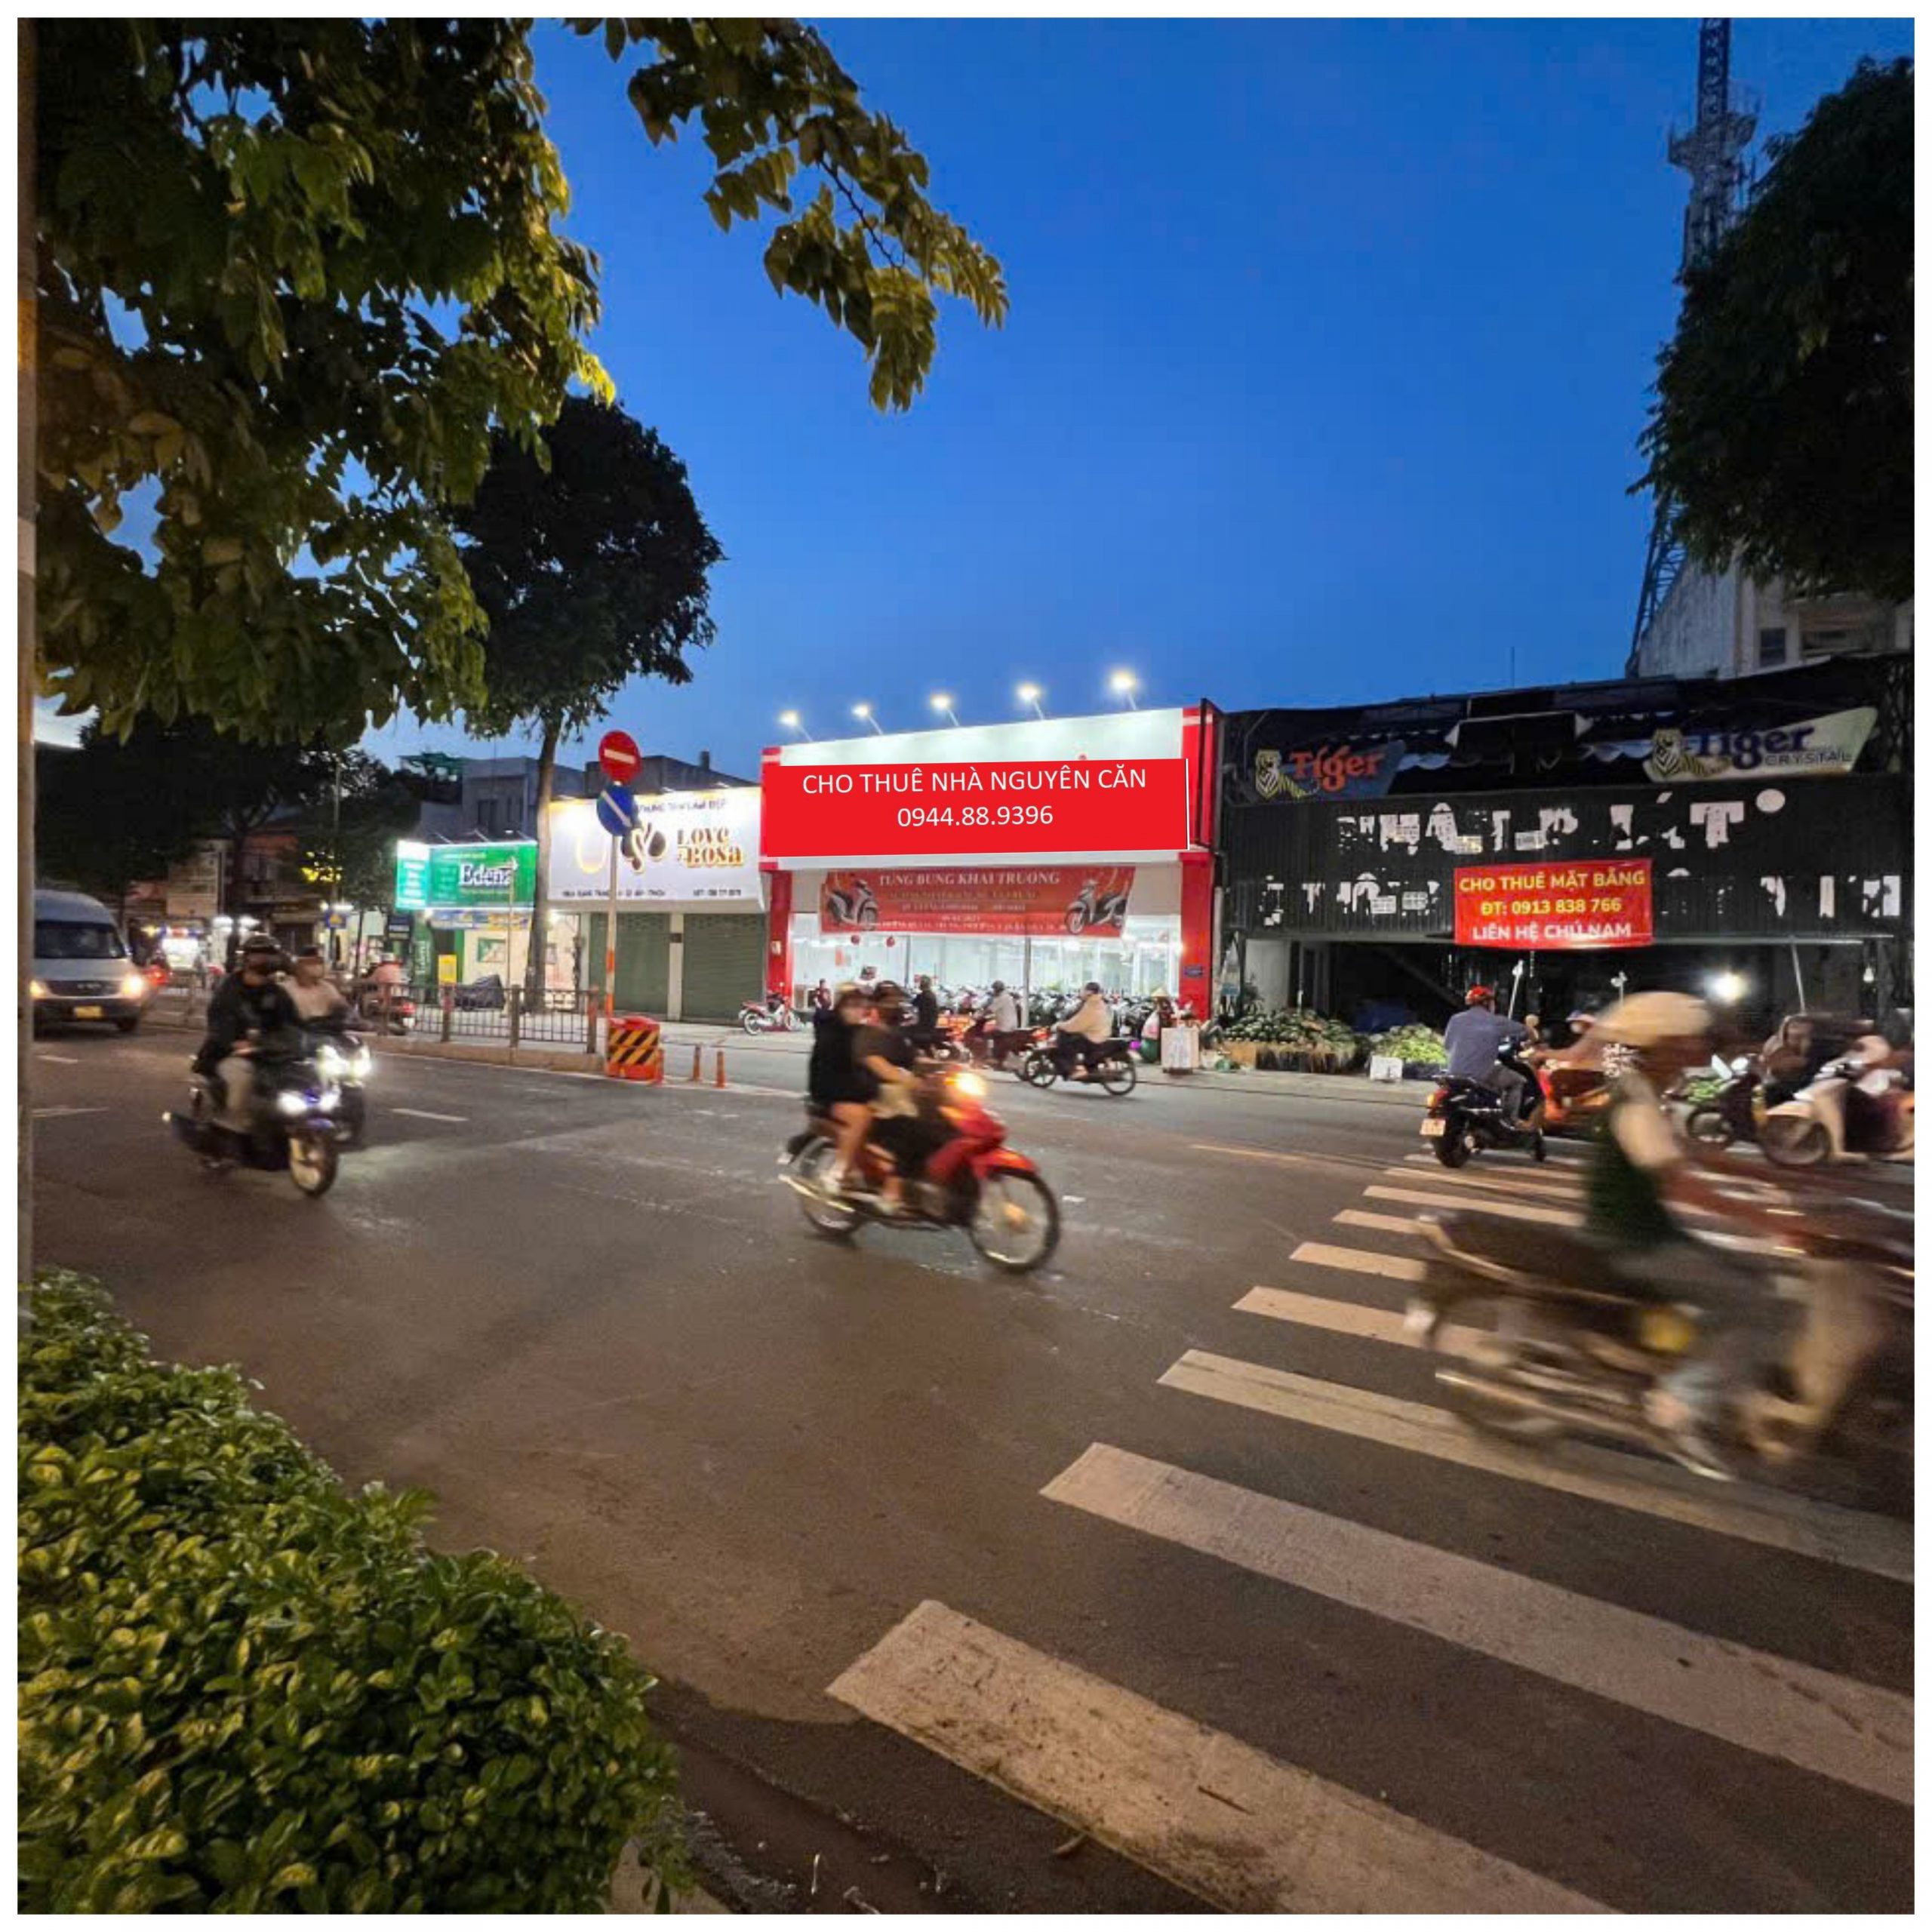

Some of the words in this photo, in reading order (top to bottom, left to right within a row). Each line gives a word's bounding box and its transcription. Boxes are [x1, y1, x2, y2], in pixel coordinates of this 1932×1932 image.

[1289, 744, 1386, 791] Tiger
[1764, 748, 1853, 765] CRYSTAL
[1459, 877, 1496, 892] CHO
[1499, 872, 1546, 891] THUÊ
[1550, 869, 1588, 892] MẶT
[1512, 899, 1551, 915] 0913
[1555, 898, 1586, 913] 838
[1591, 897, 1623, 912] 766
[1472, 921, 1510, 940] LIÊN
[1515, 920, 1540, 943] HỆ
[1586, 922, 1632, 938] NAM
